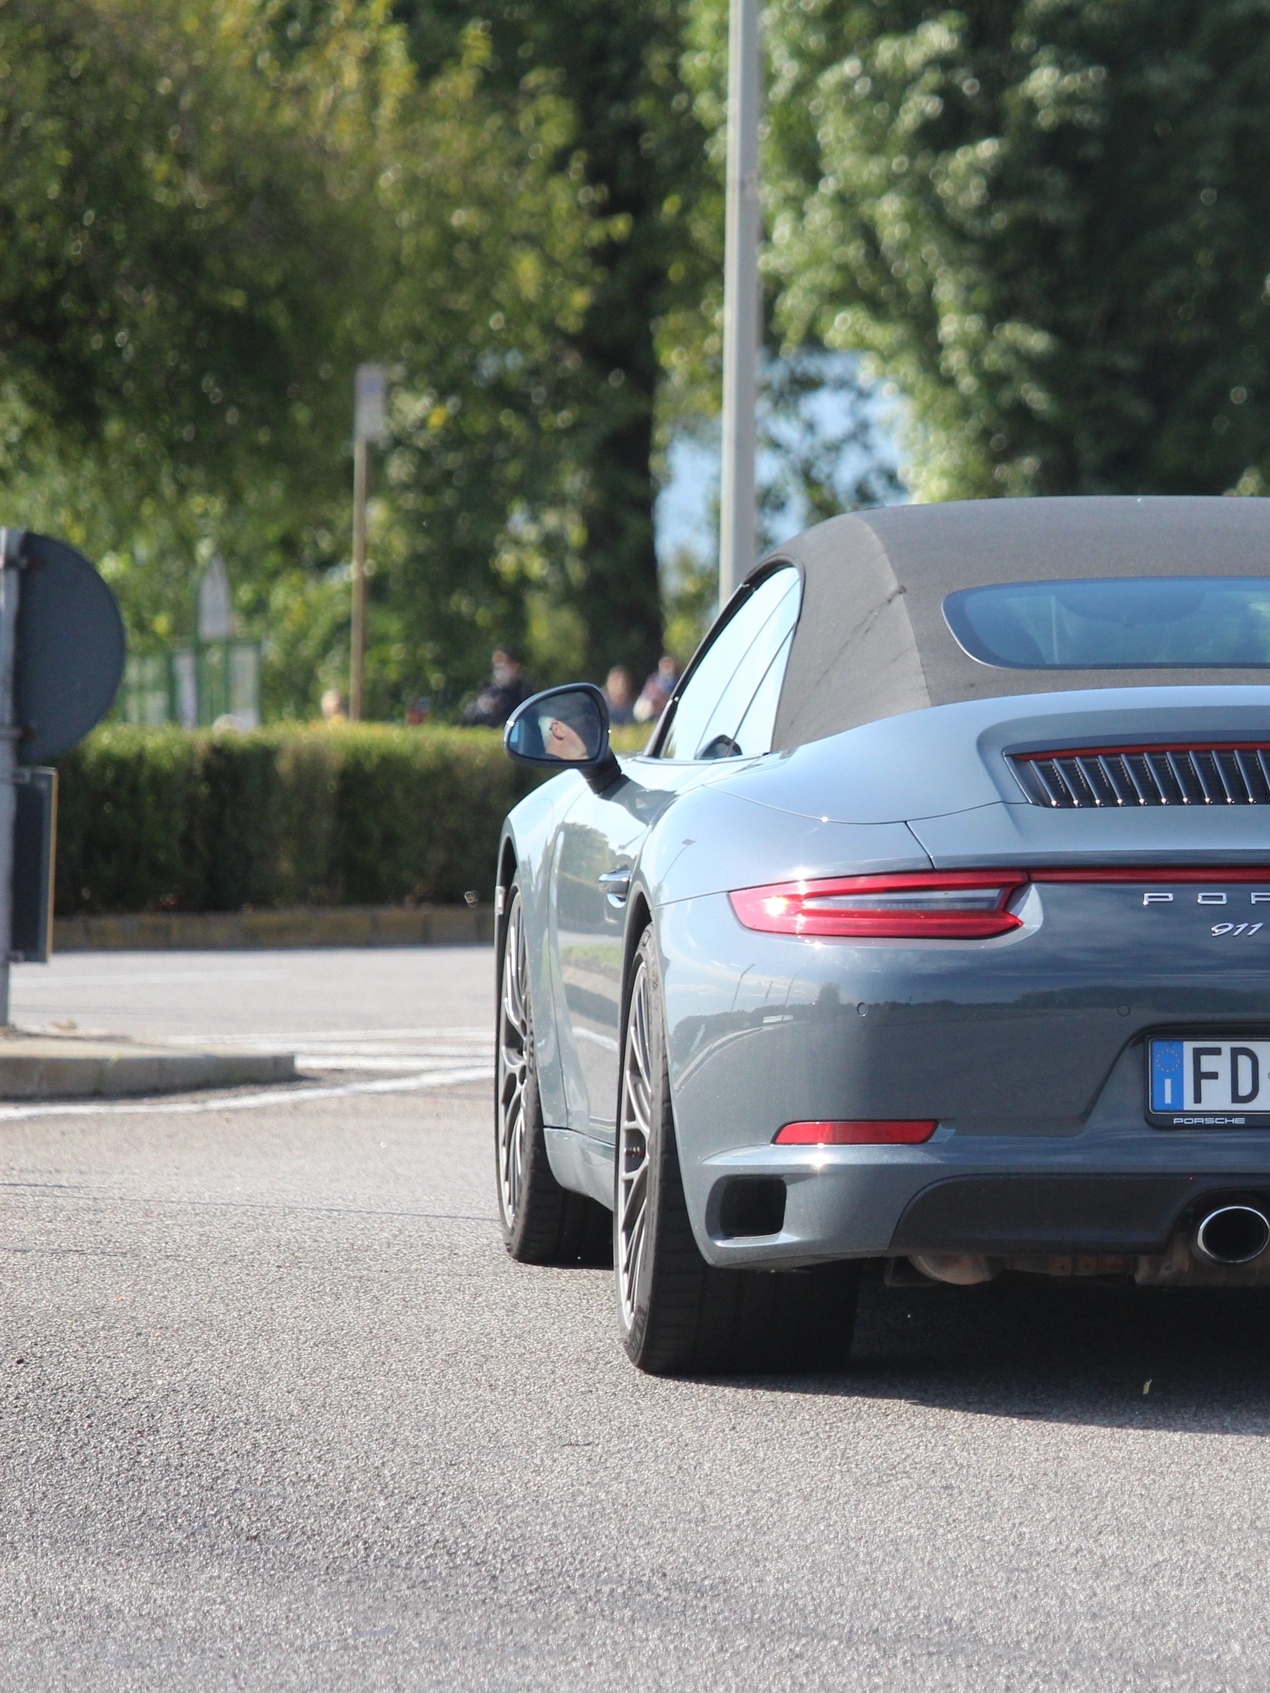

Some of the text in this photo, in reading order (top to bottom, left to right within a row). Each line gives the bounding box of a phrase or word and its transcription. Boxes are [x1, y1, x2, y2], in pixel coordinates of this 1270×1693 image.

[1211, 922, 1263, 937] 911
[1192, 1046, 1260, 1105] FD
[1173, 1117, 1246, 1125] PORSCHE
